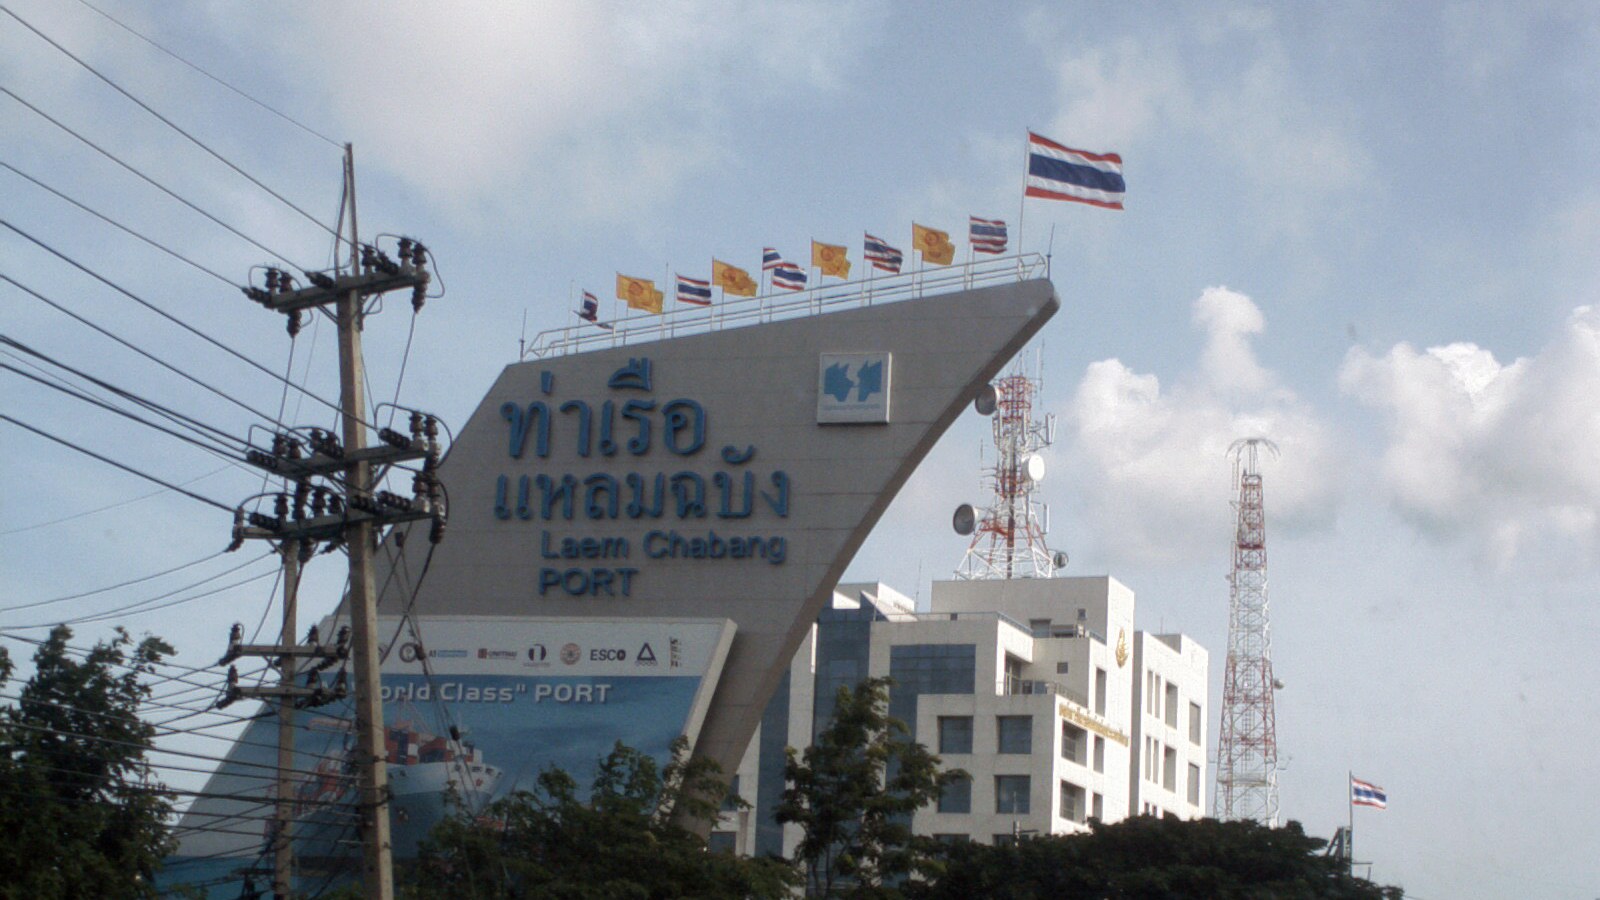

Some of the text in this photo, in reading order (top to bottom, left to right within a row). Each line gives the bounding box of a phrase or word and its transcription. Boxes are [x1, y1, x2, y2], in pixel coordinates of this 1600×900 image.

[500, 357, 707, 459] ท่าเรือ
[494, 444, 790, 521] แหลมฉบัง
[541, 529, 788, 565] Laem Chabang
[539, 567, 640, 597] PORT
[589, 649, 626, 661] ESCO
[440, 682, 526, 702] Class"
[535, 684, 612, 703] PORT
